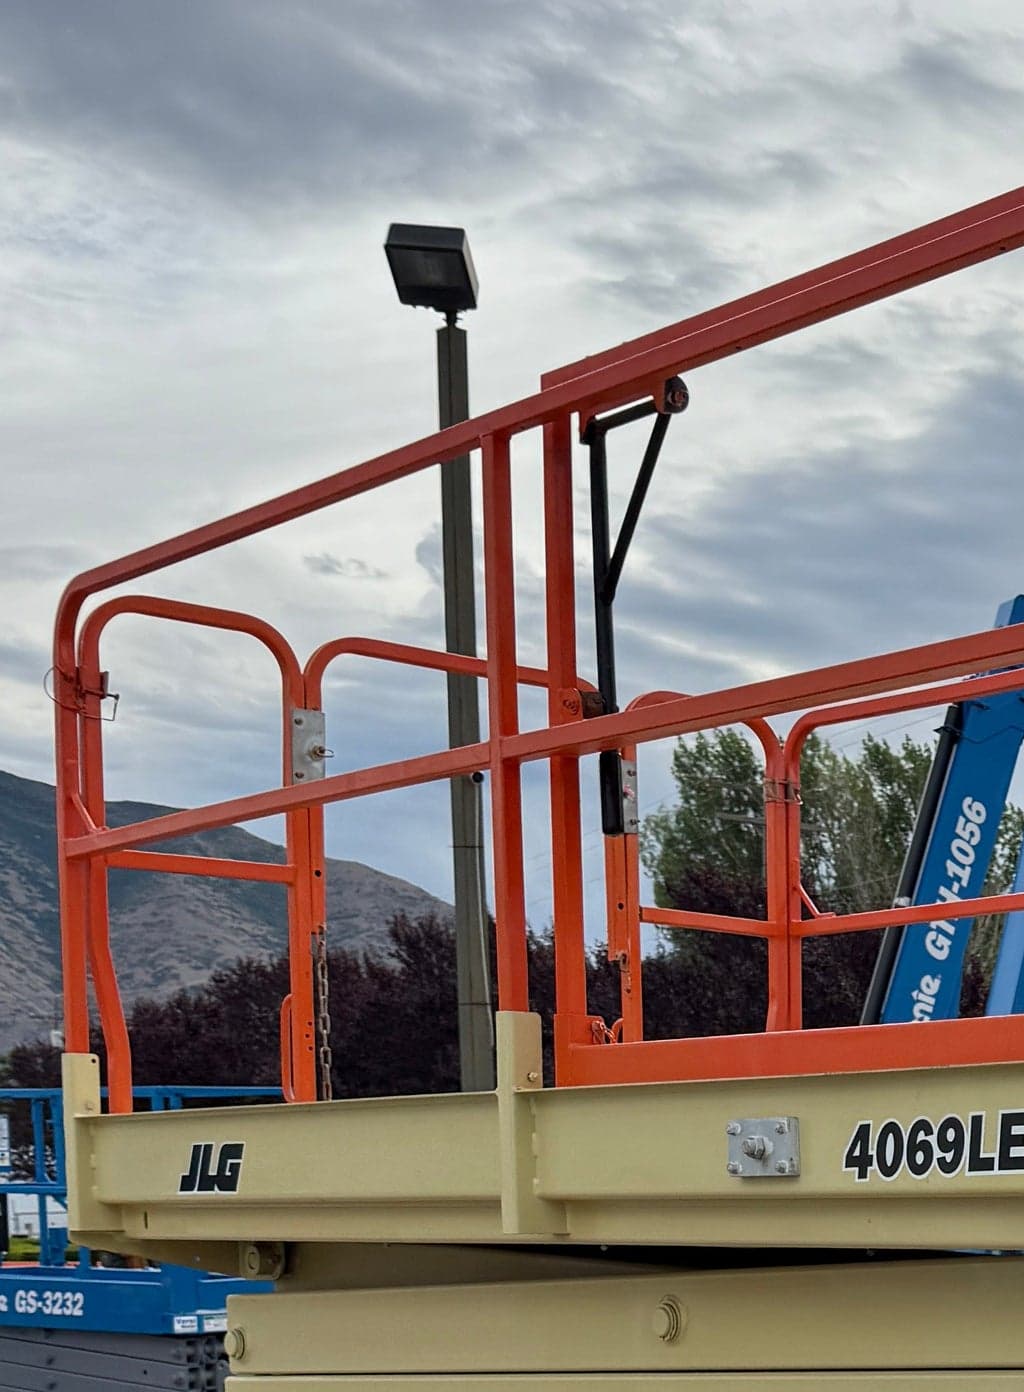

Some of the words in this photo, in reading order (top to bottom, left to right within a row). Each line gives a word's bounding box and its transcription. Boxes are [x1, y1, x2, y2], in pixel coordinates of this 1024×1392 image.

[911, 974, 942, 1022] nie
[178, 1142, 246, 1193] JLG
[15, 1289, 84, 1316] GS-3232
